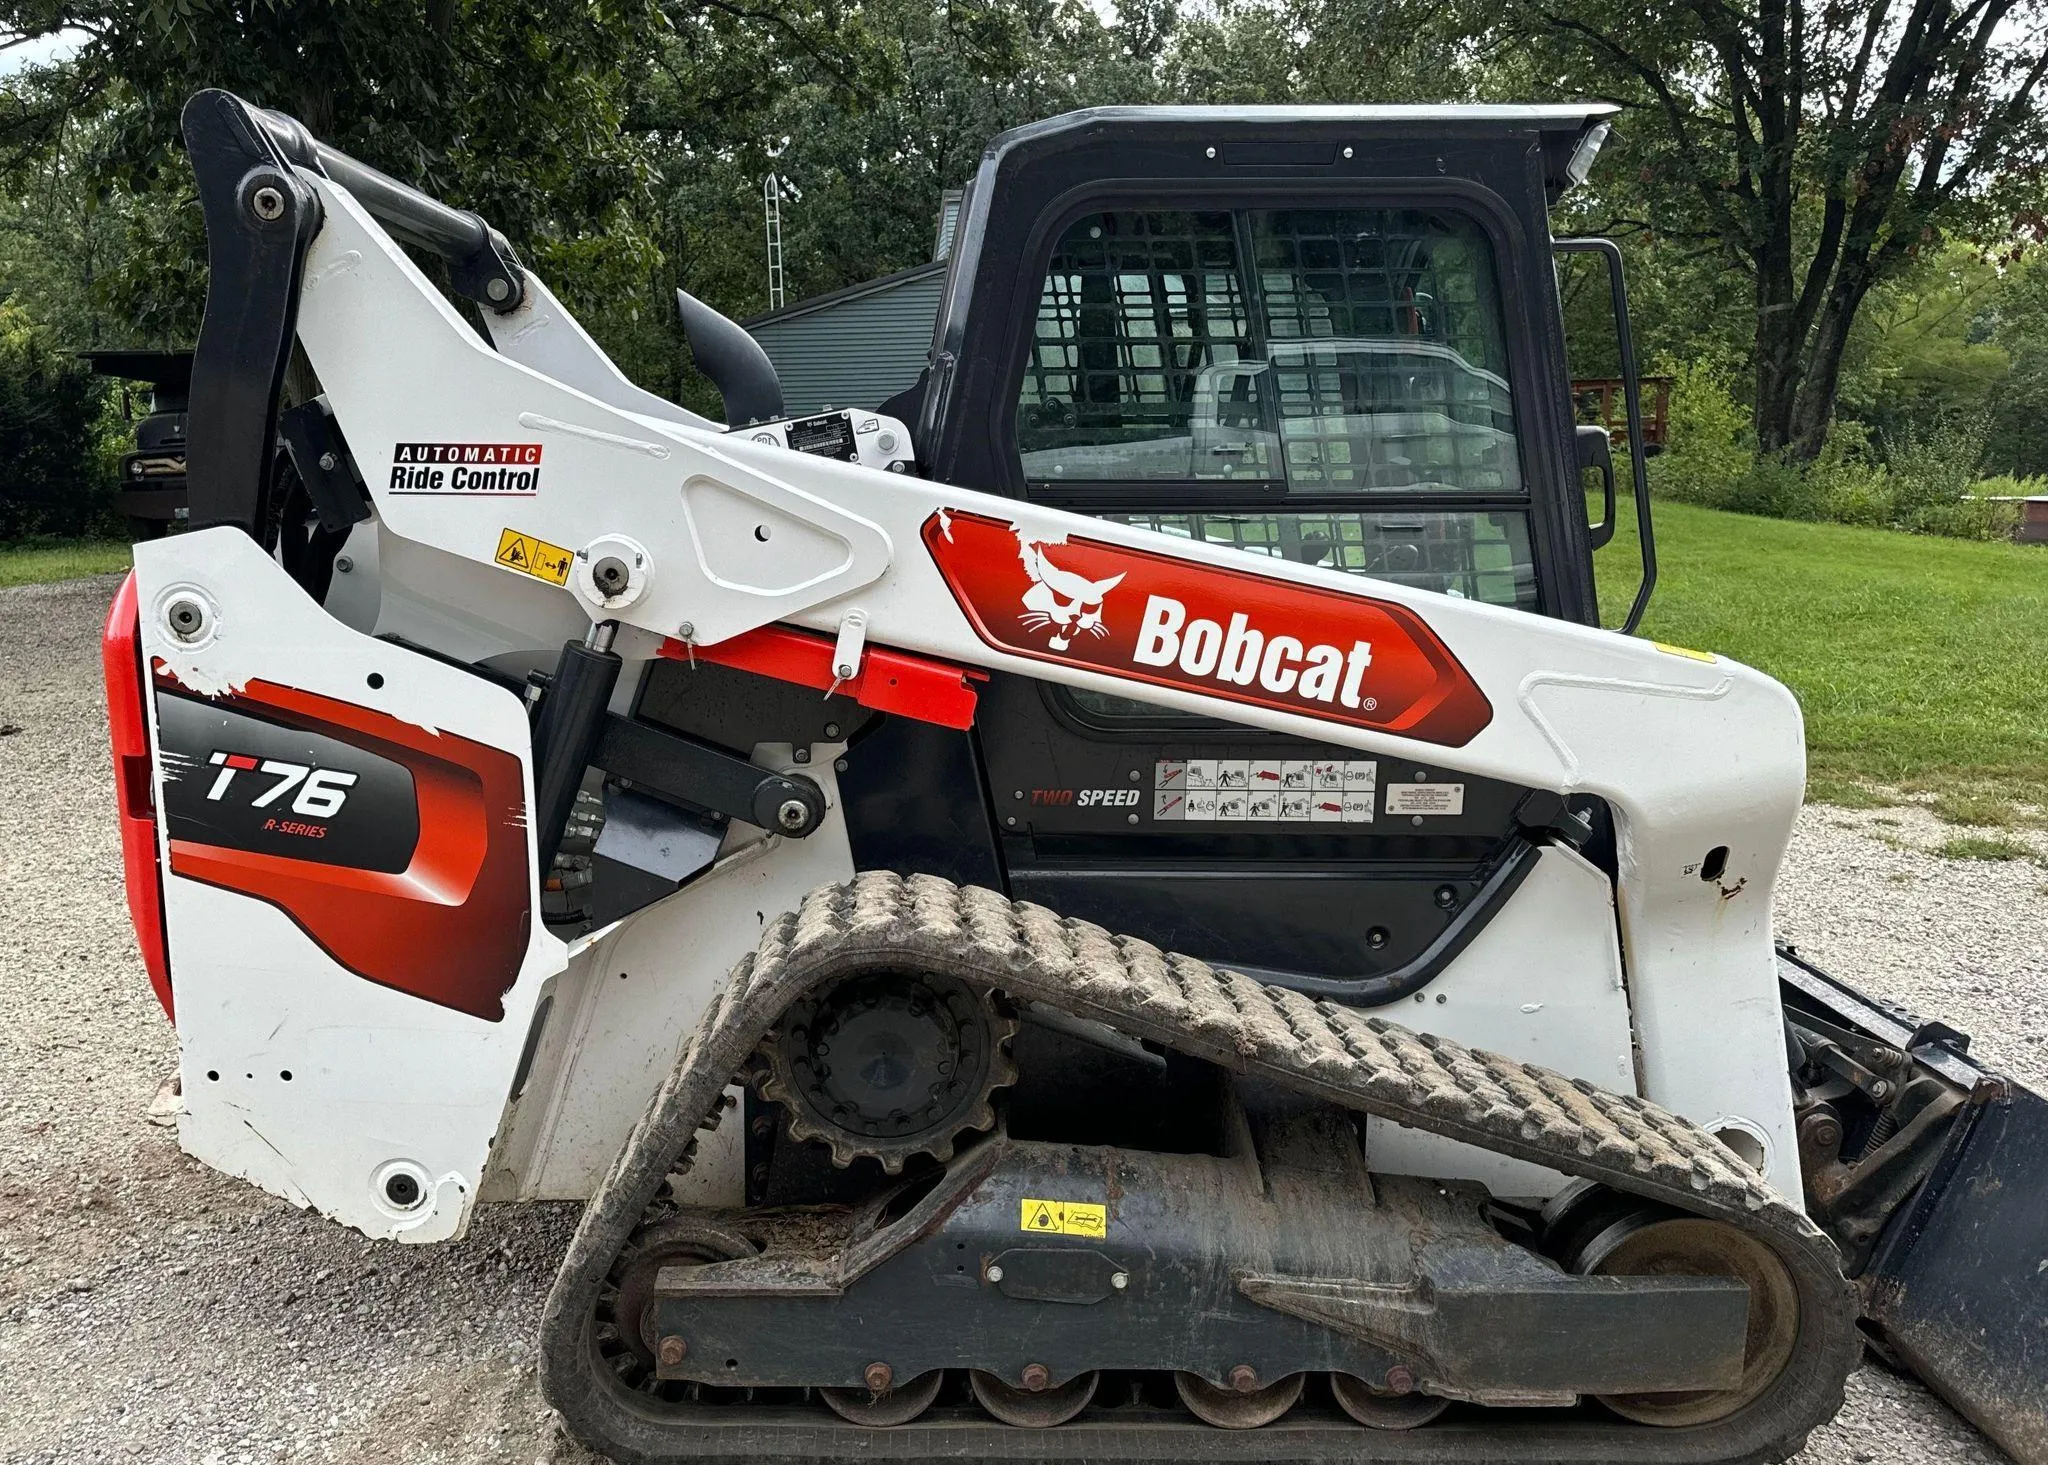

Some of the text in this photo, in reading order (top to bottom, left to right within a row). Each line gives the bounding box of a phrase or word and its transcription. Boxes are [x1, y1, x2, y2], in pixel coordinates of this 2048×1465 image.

[399, 447, 537, 462] AUTOMATIC
[389, 466, 540, 491] Ride Control
[206, 752, 358, 818] T76
[1031, 788, 1140, 807] TWO SPEED
[264, 818, 327, 839] R-SERIES
